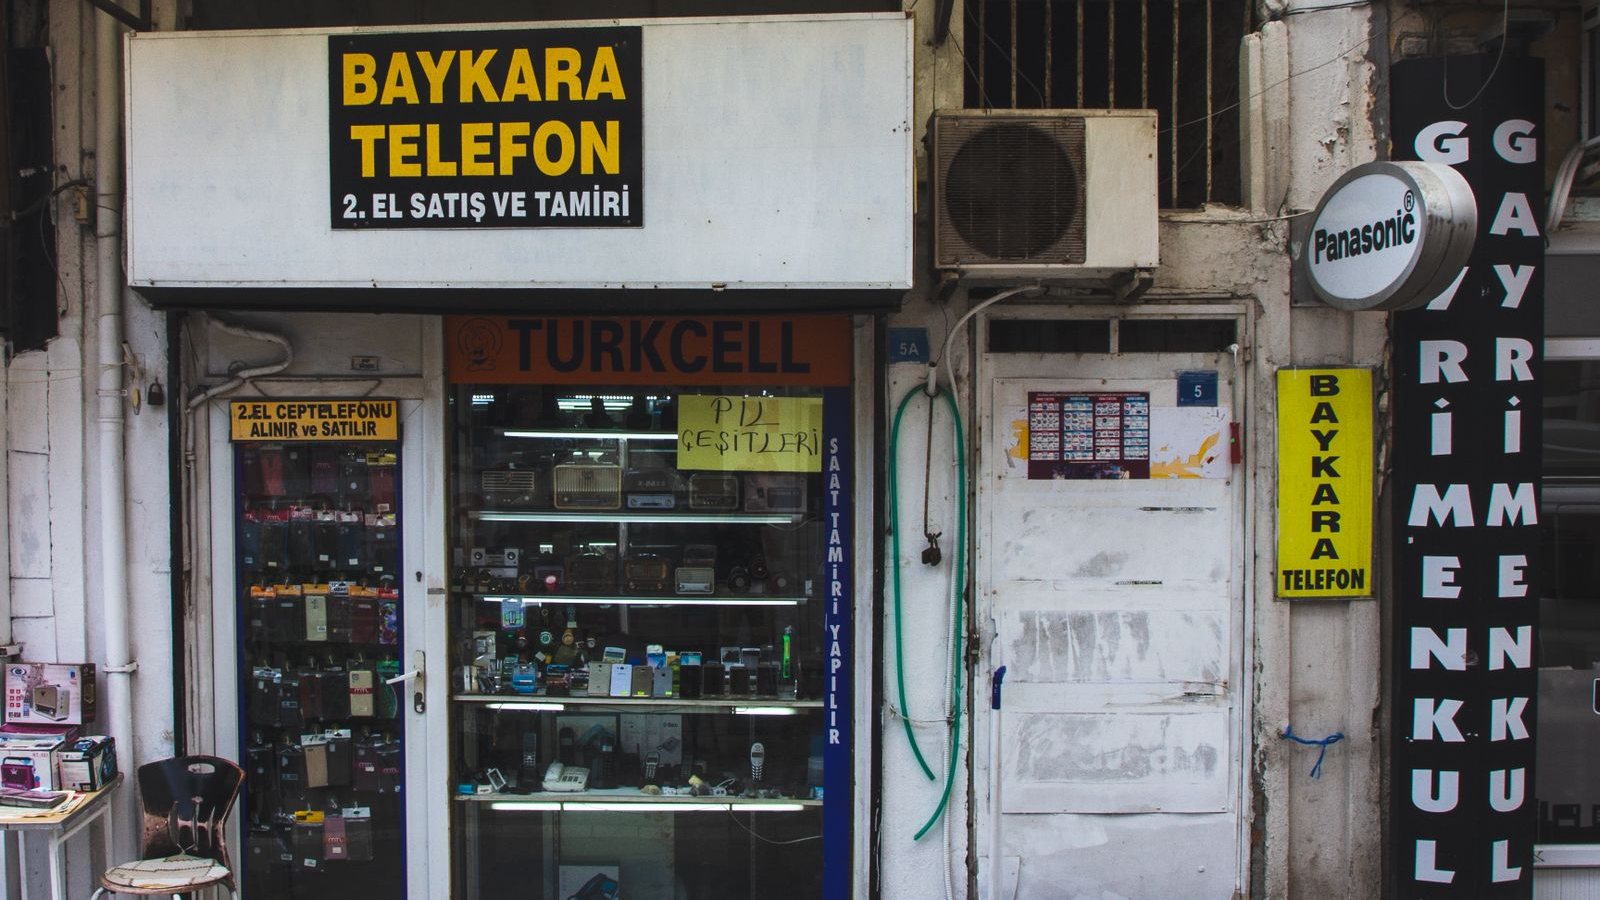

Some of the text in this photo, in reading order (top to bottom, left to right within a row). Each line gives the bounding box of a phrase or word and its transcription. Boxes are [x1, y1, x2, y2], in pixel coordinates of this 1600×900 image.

[342, 46, 626, 106] BAYKARA
[350, 120, 620, 177] TELEFON
[343, 184, 630, 223] 2. EL SATIŞ VE TAMİRİ
[1315, 209, 1415, 265] Panasonic
[507, 319, 811, 373] TURKCELL
[900, 342, 919, 356] 5A
[1194, 385, 1202, 398] 5
[250, 420, 377, 438] ALINIR ve SATILIR
[829, 438, 841, 506] SAAT
[1309, 375, 1341, 560] BAYKARA
[1282, 568, 1365, 590] TELEFON
[829, 625, 842, 744] YAPILIR
